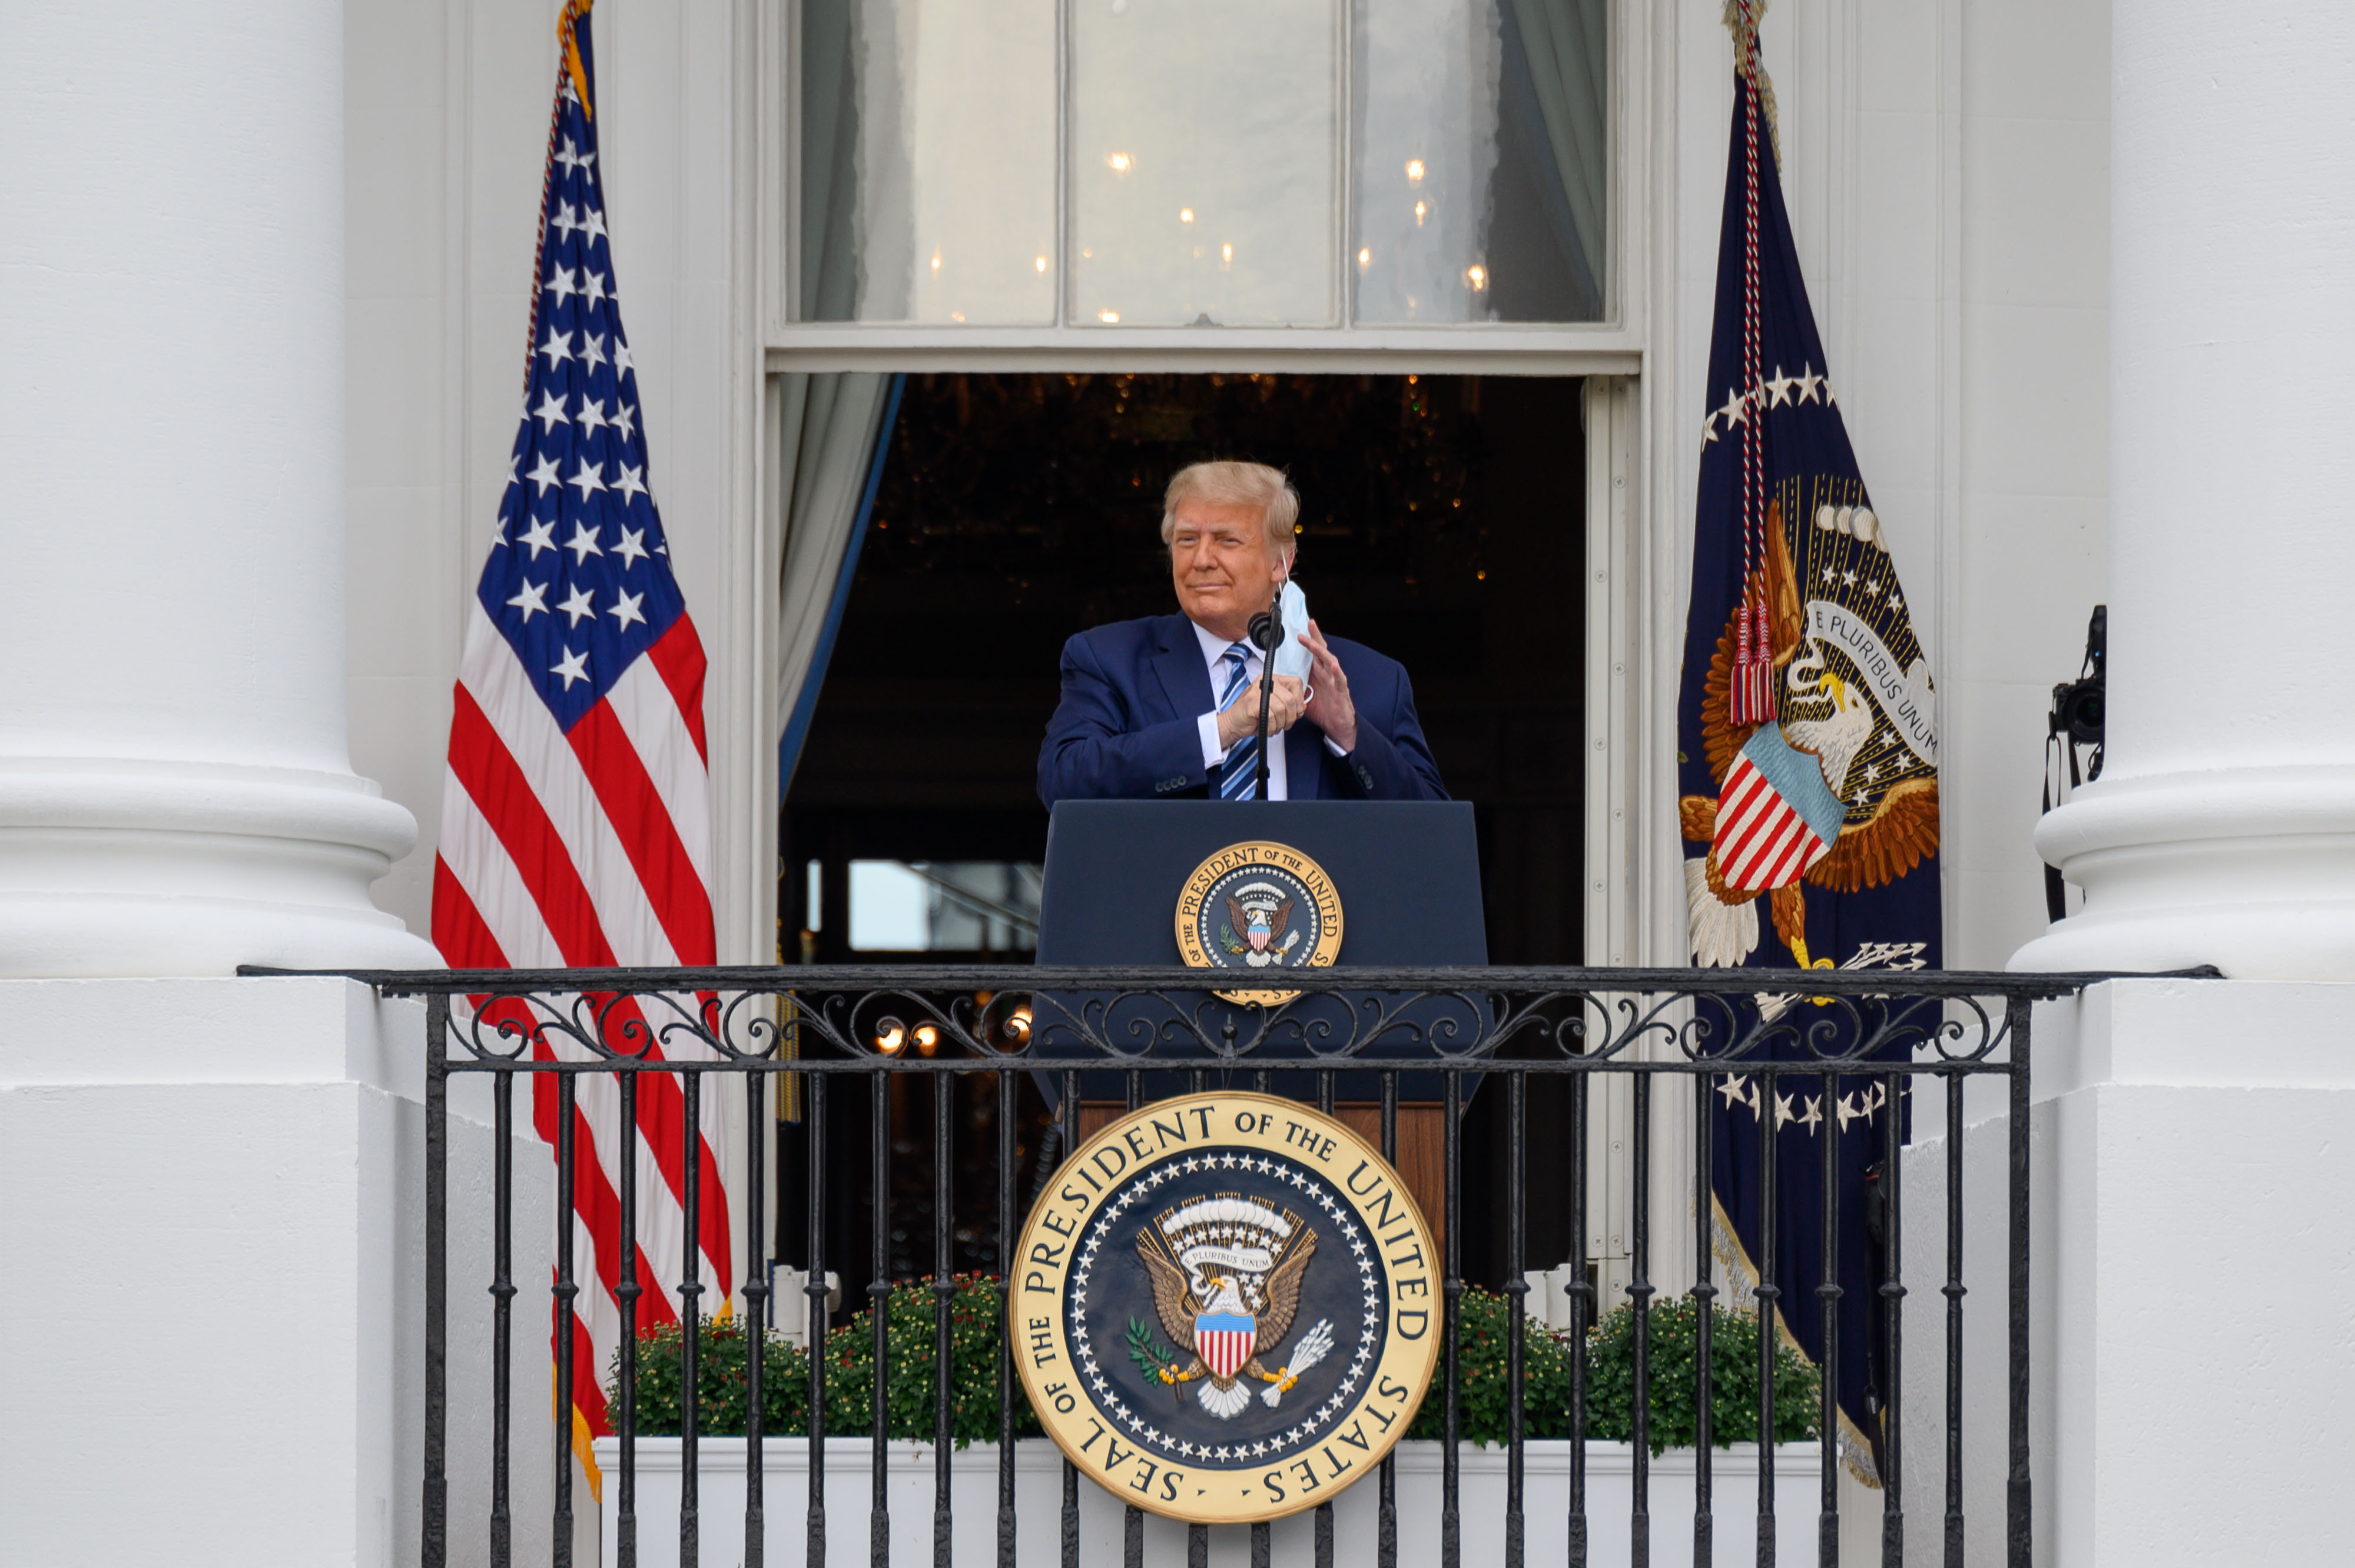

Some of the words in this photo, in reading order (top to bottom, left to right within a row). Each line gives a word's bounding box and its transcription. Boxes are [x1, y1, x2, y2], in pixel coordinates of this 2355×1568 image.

[1816, 611, 1823, 629] E
[1830, 616, 1902, 700] PLURIBUS
[1898, 699, 1938, 755] UNUM
[1265, 850, 1279, 861] OF
[1283, 854, 1303, 871] THE
[1182, 848, 1259, 918] PRESIDENT
[1305, 870, 1338, 937] UNITED
[1183, 923, 1194, 945] THE
[1189, 946, 1200, 962] OF
[1235, 1111, 1273, 1135] OF
[1286, 1121, 1337, 1162] THE
[1025, 1106, 1215, 1295] PRESIDENT
[1185, 1257, 1192, 1265] E
[1192, 1251, 1238, 1264] PLURIBUS
[1242, 1258, 1269, 1268] UNUM
[1347, 1159, 1428, 1340] UNITED
[1029, 1316, 1057, 1369] THE
[1044, 1382, 1076, 1414] OF
[1080, 1417, 1184, 1501] SEAL
[1263, 1375, 1408, 1503] STATES
